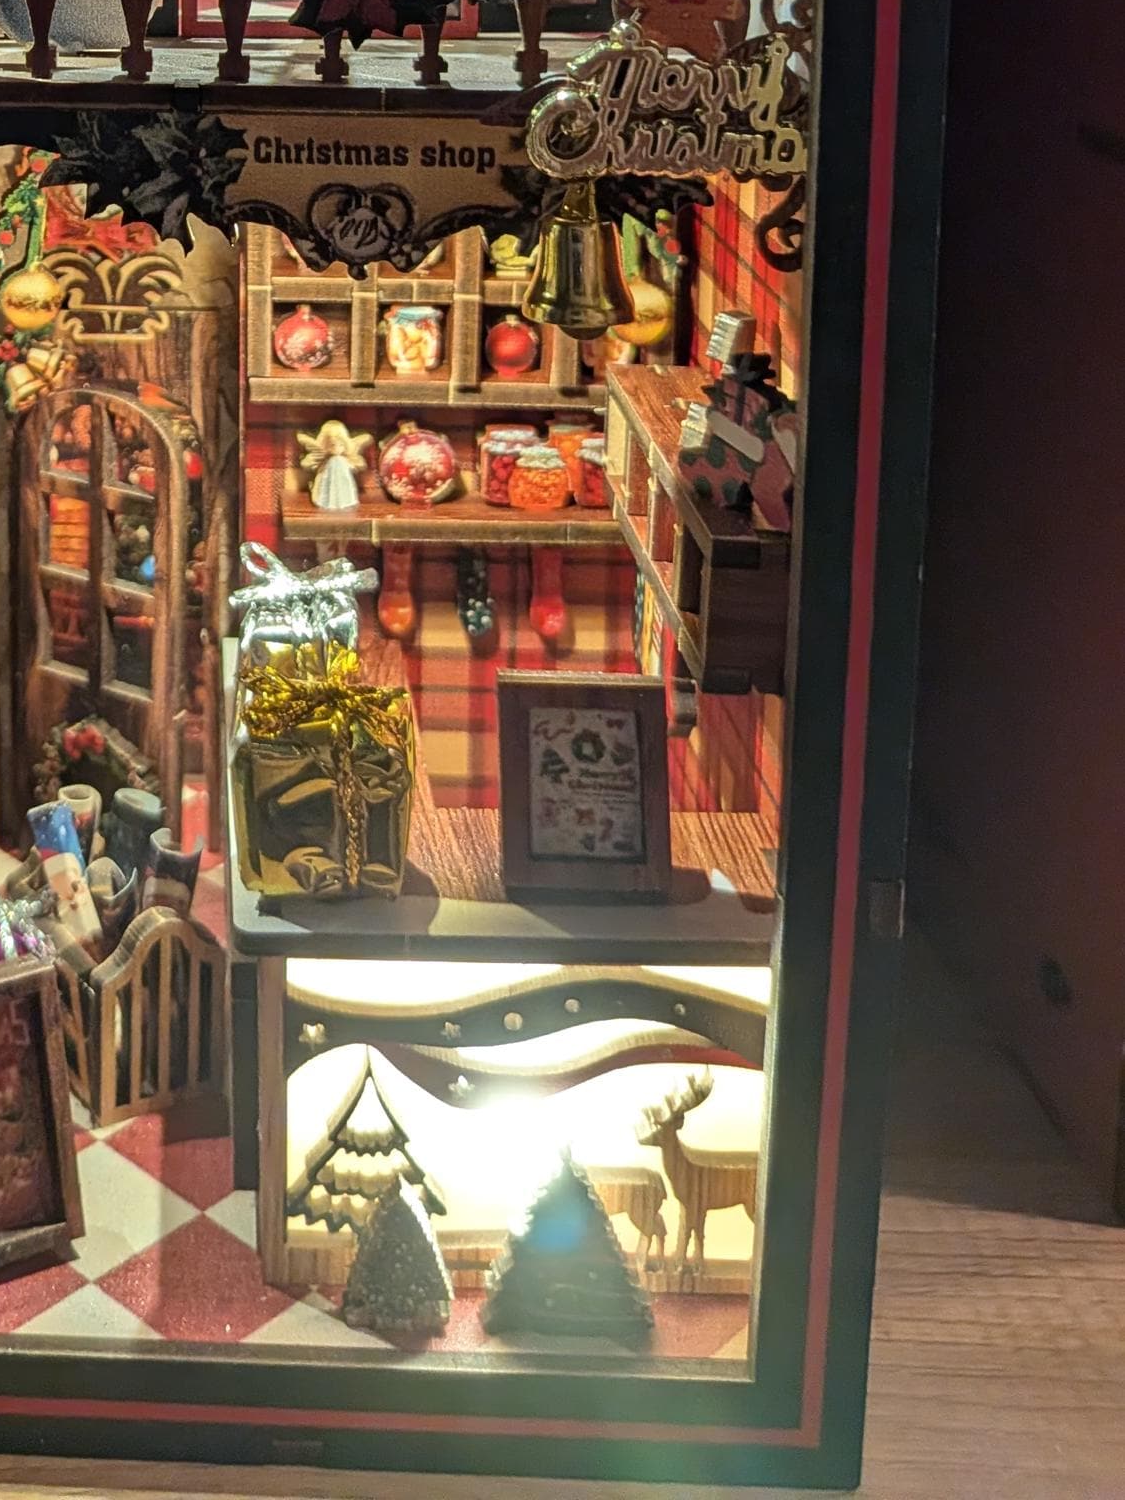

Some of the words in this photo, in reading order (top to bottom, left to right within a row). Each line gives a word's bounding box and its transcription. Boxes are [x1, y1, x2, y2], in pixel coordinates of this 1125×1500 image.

[567, 33, 790, 132] Merry
[253, 135, 409, 167] Christmas
[420, 140, 496, 174] shop
[527, 90, 807, 179] Christma
